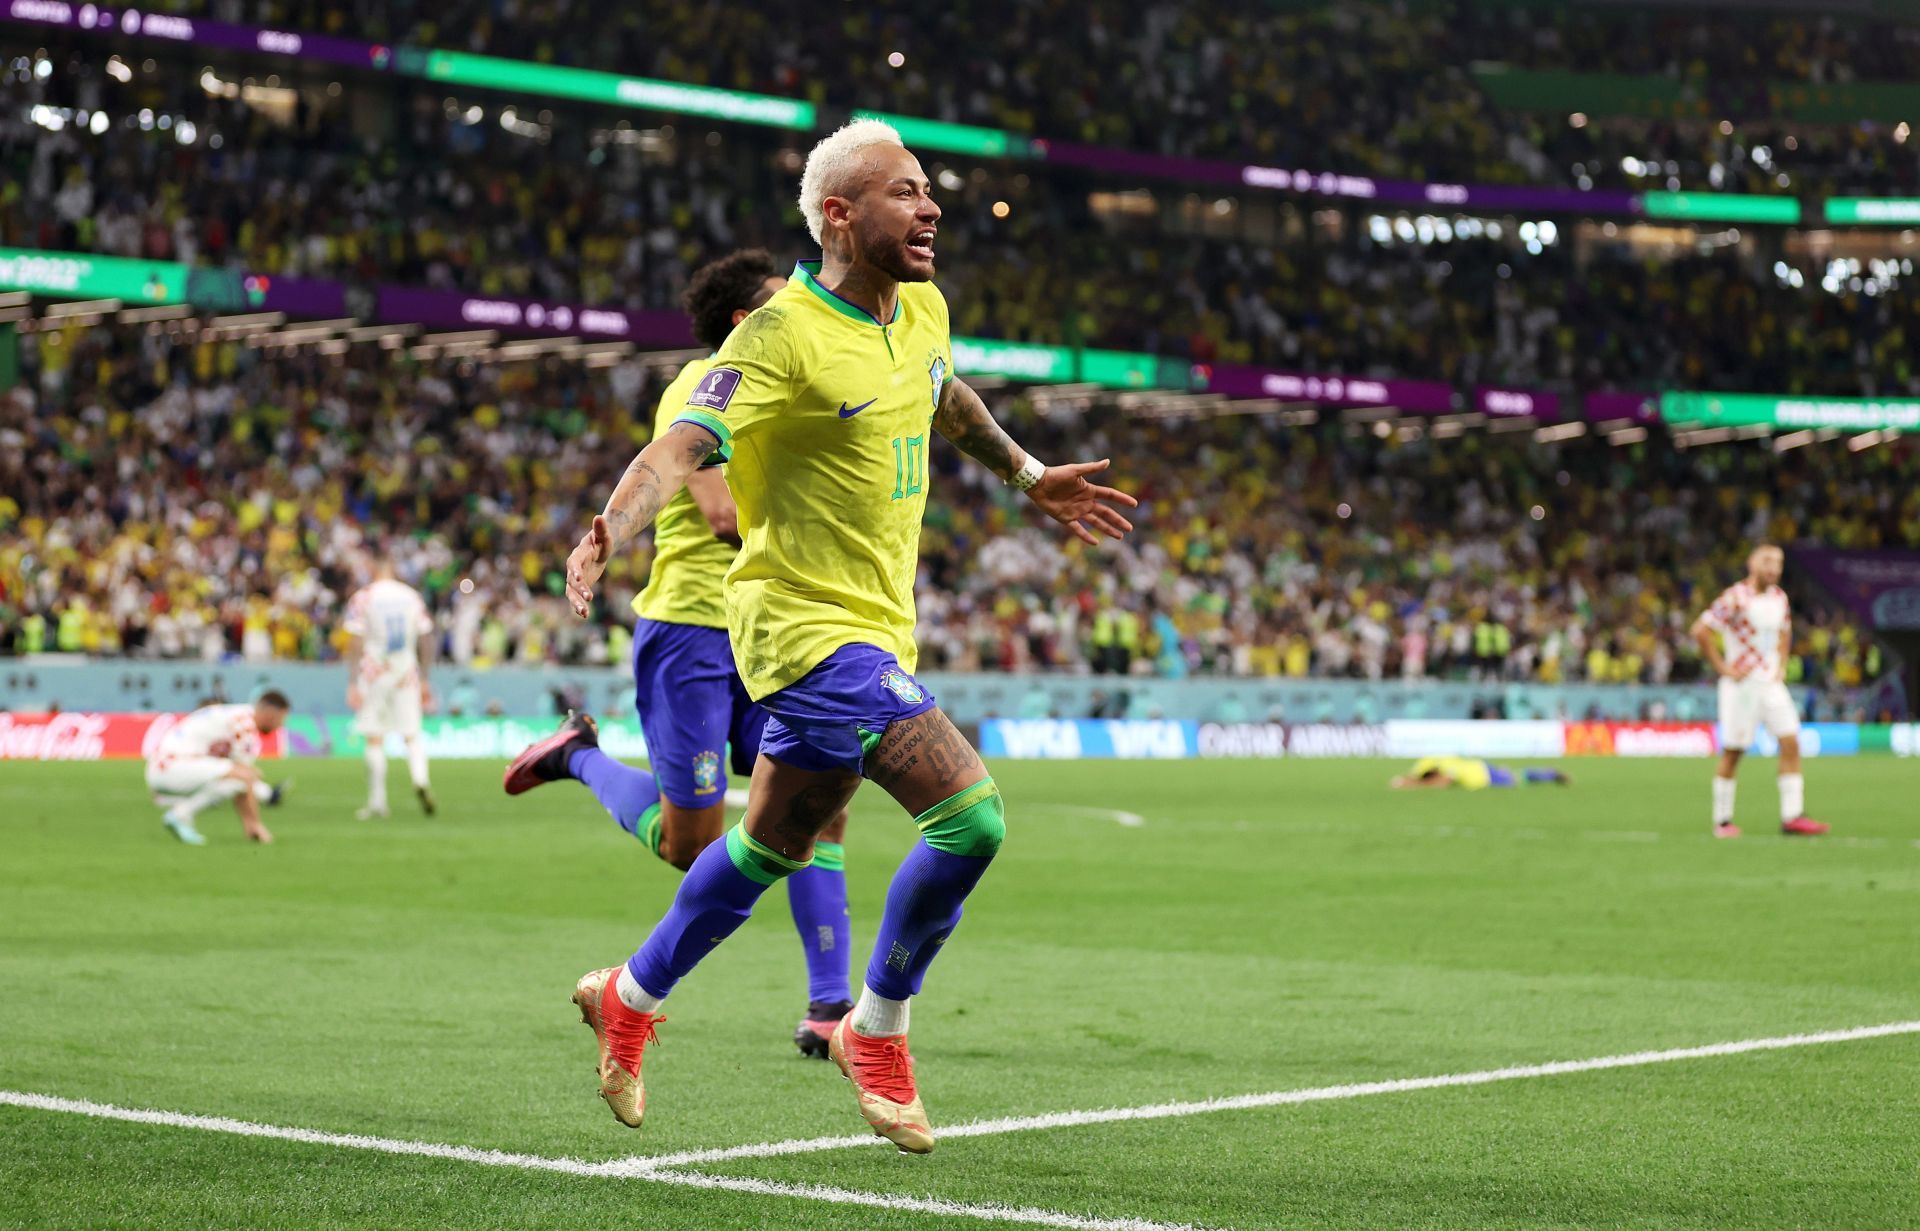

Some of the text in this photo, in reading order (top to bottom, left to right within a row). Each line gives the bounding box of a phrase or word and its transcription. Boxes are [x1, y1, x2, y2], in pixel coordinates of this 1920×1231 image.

[891, 433, 923, 501] 10
[903, 732, 923, 752] SOU
[998, 719, 1083, 758] VISA
[1104, 719, 1188, 758] VISA
